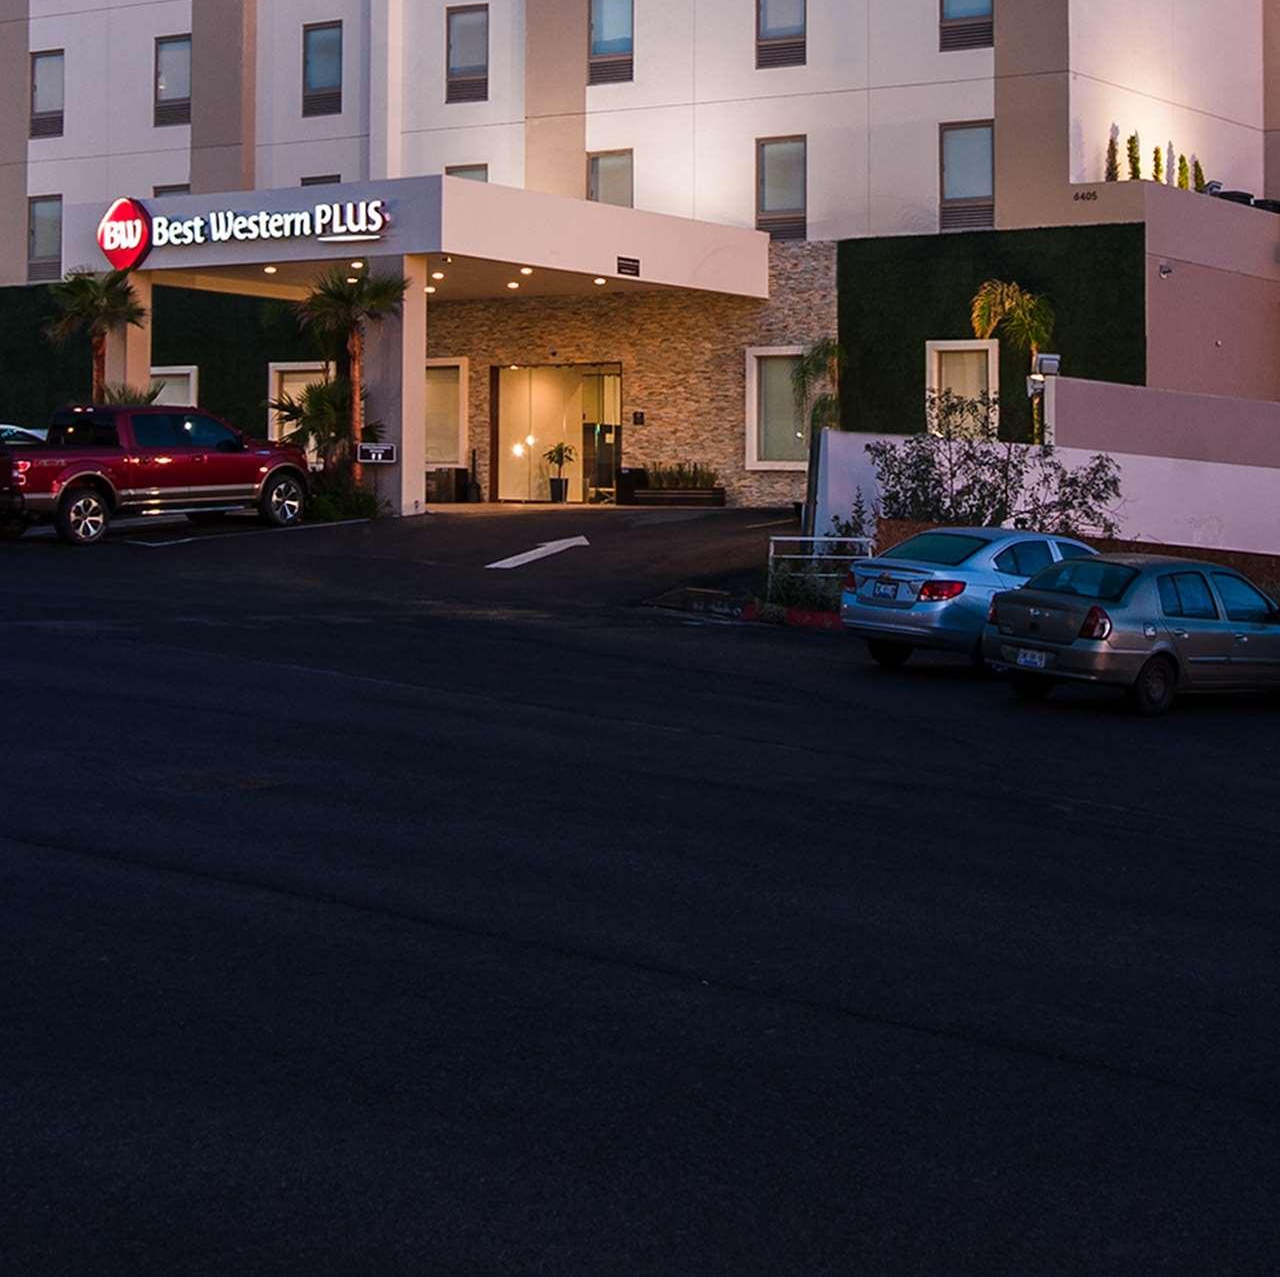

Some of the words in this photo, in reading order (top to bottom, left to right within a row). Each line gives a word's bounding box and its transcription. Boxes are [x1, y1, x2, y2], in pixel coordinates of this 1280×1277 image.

[102, 219, 143, 250] BW
[152, 216, 206, 247] Best
[210, 210, 312, 242] Western
[315, 200, 384, 236] PLUS
